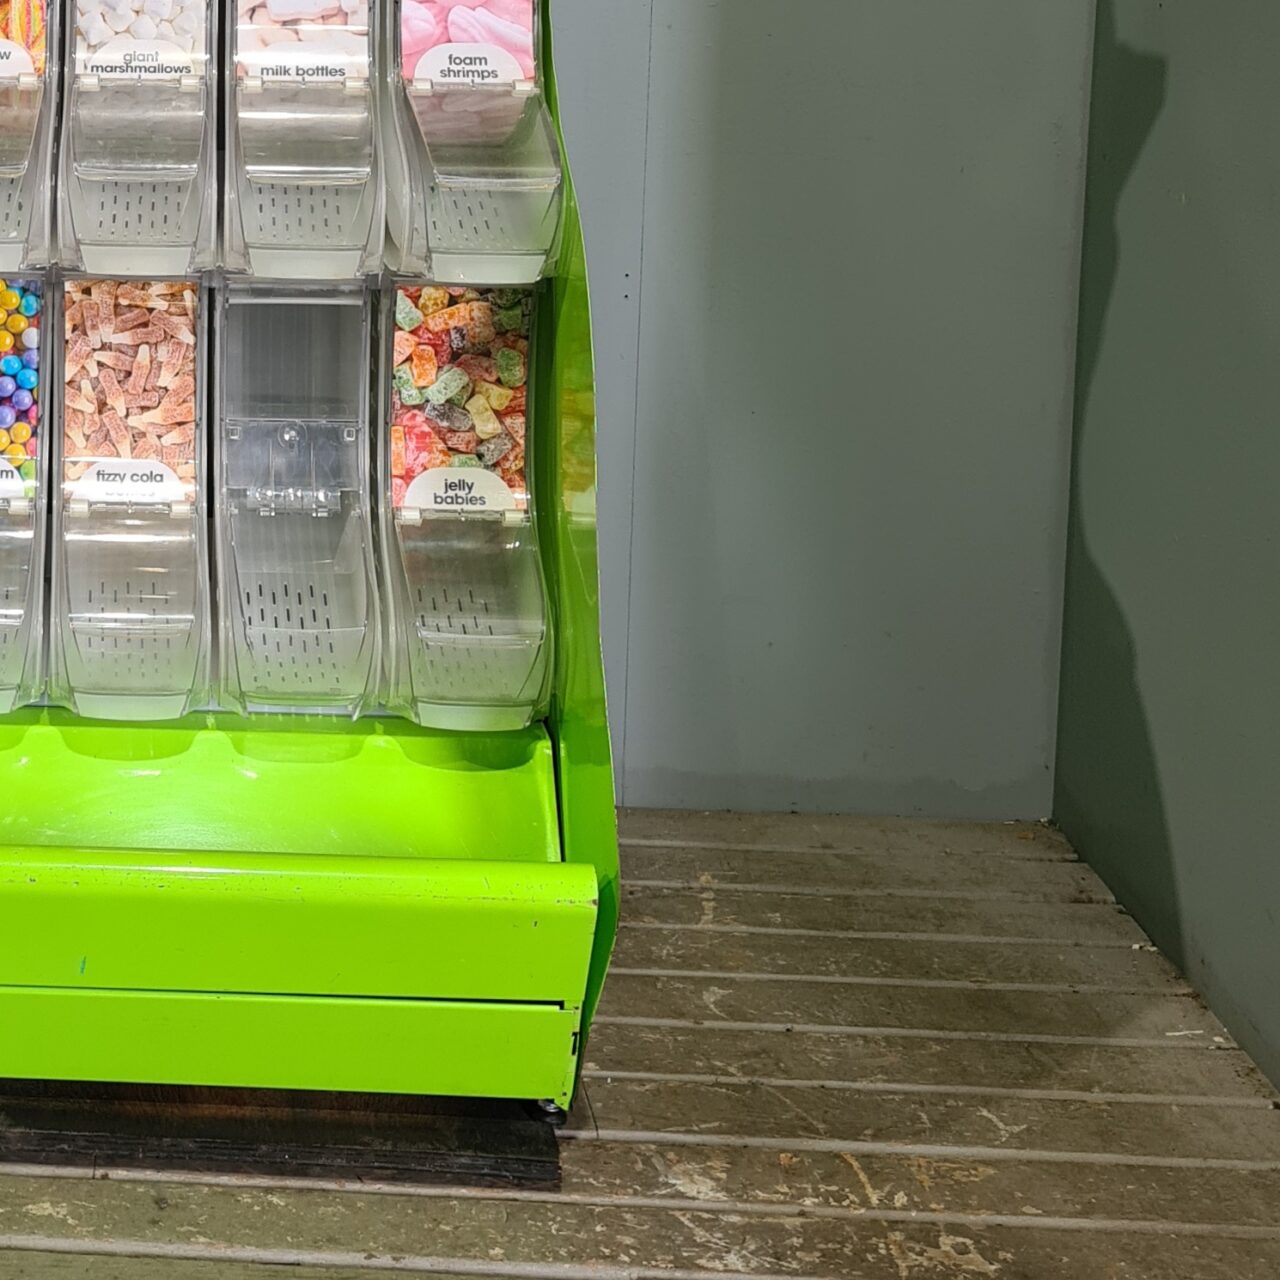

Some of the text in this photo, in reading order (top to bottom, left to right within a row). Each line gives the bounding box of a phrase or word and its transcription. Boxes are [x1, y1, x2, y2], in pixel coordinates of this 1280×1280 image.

[123, 51, 159, 64] giant
[448, 53, 488, 66] foam
[90, 63, 192, 74] marshmallows
[260, 64, 346, 77] milk bottles
[439, 66, 499, 80] shrimps
[96, 470, 164, 483] fizzy cola
[444, 478, 474, 493] jelly
[433, 493, 486, 506] babies
